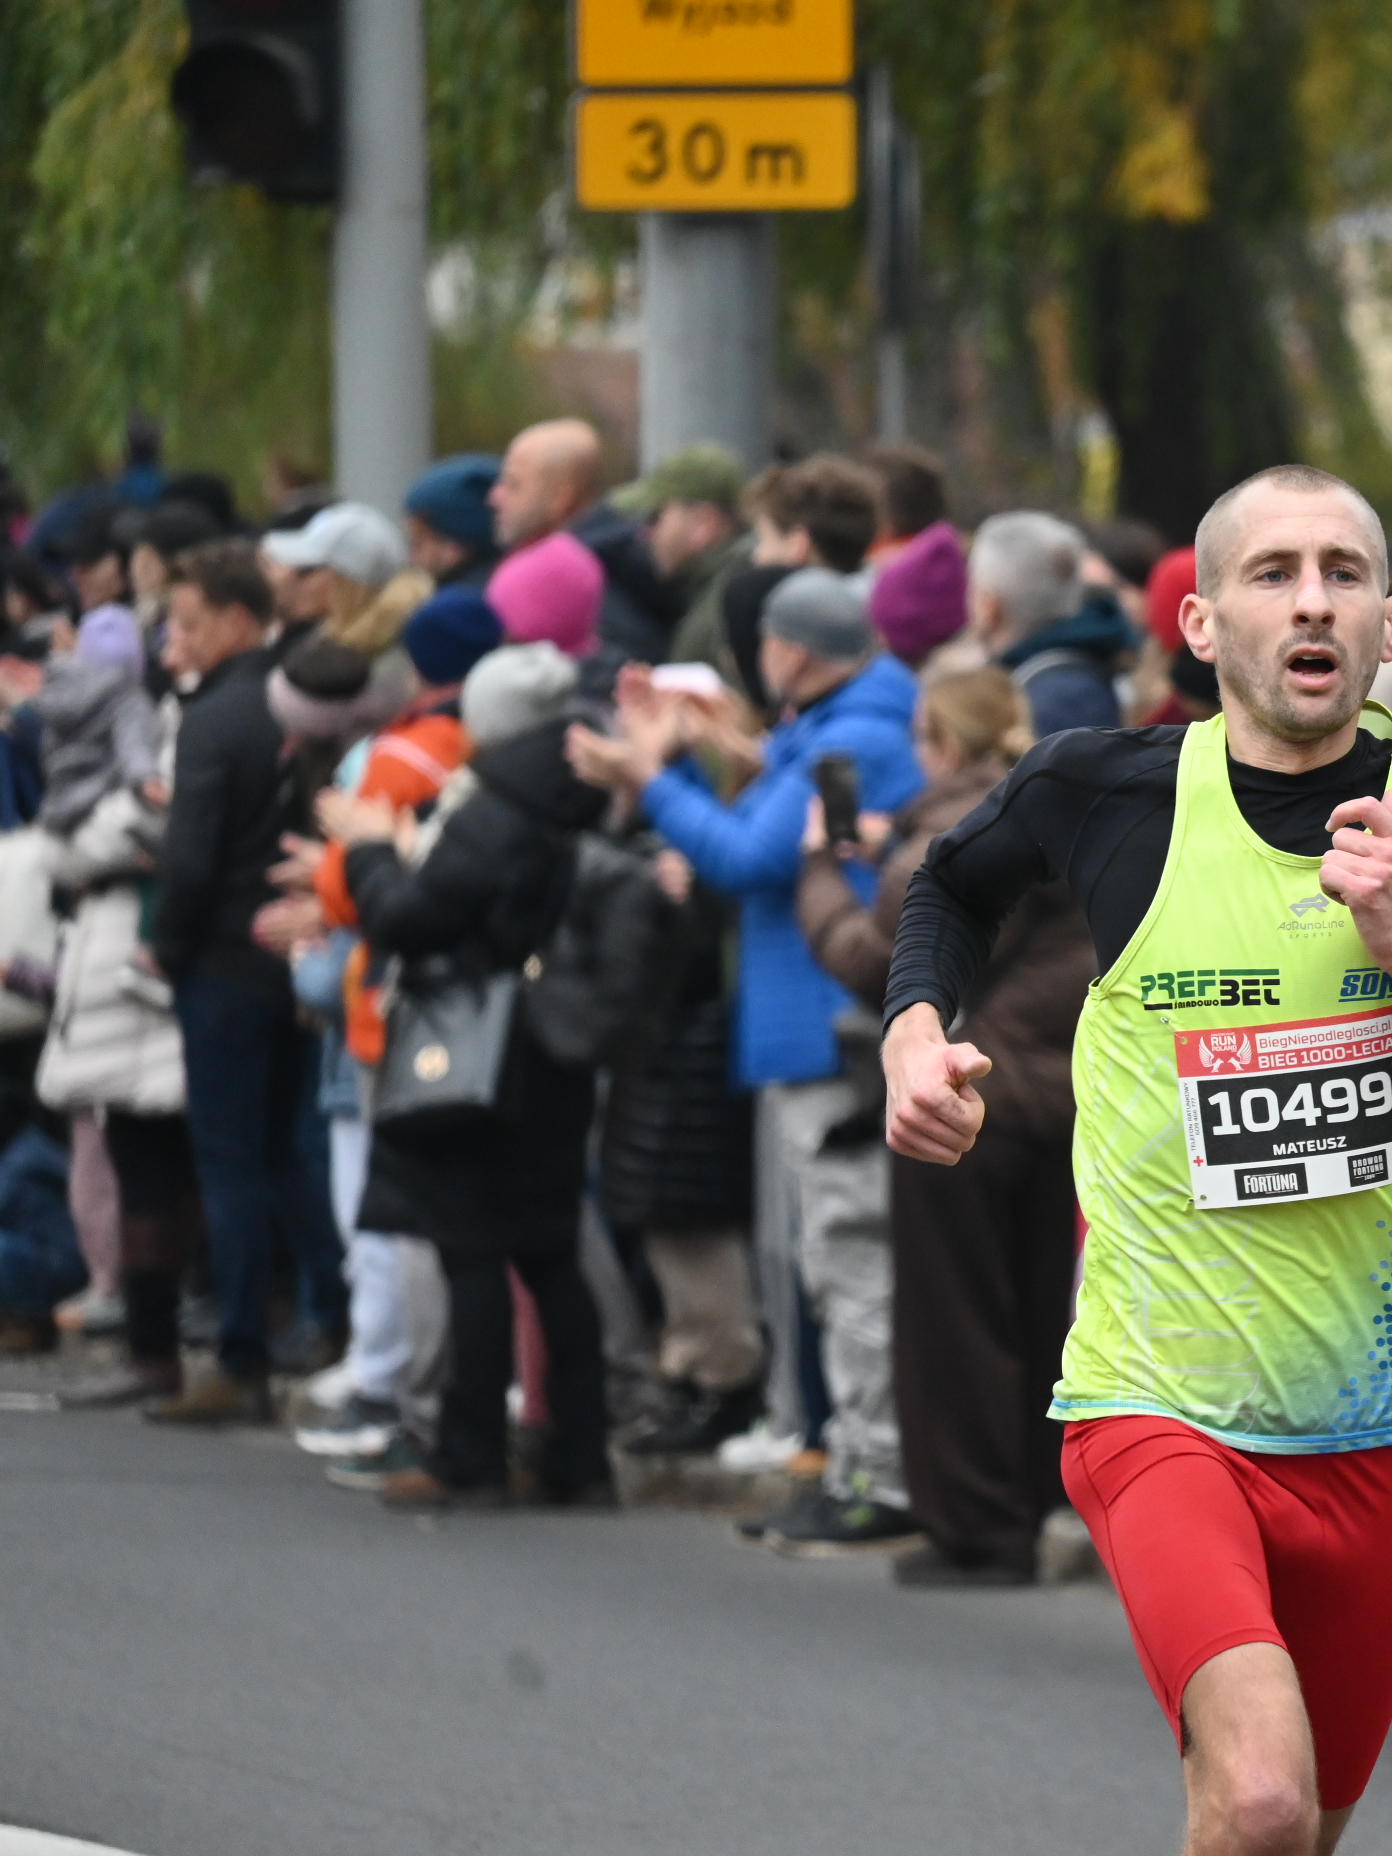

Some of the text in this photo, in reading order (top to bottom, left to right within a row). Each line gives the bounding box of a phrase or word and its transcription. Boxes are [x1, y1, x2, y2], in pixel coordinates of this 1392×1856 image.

[627, 117, 805, 185] 30 m
[1211, 1035, 1237, 1046] RUN
[1259, 1019, 1391, 1049] BiegNiepodleglosci.pl
[1258, 1053, 1298, 1069] BIEG
[1273, 1136, 1347, 1155] MATEUSZ
[1243, 1173, 1299, 1194] FORTUNA
